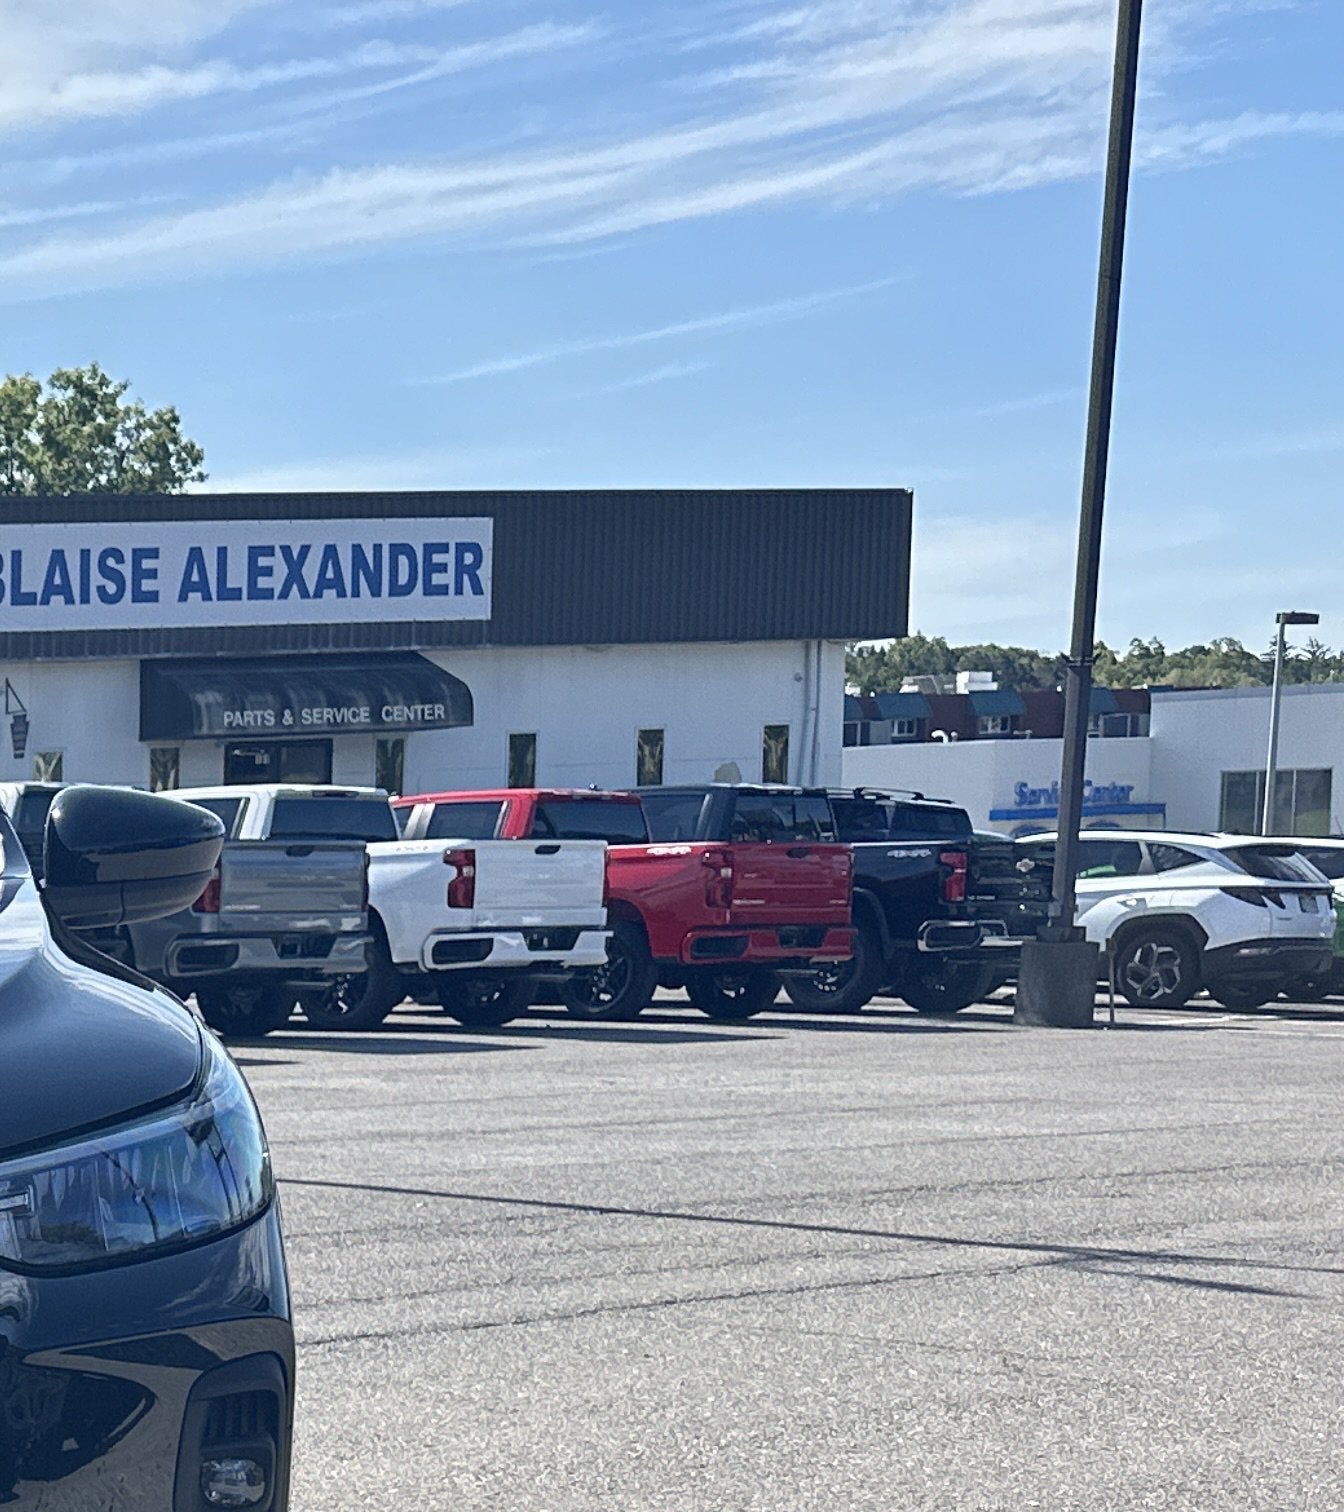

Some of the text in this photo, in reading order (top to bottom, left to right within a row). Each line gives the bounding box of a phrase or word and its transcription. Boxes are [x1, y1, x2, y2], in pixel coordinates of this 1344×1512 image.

[178, 542, 485, 602] ALEXANDER
[223, 703, 446, 728] PARTS & SERVICE CENTER
[1014, 781, 1059, 806] Servi
